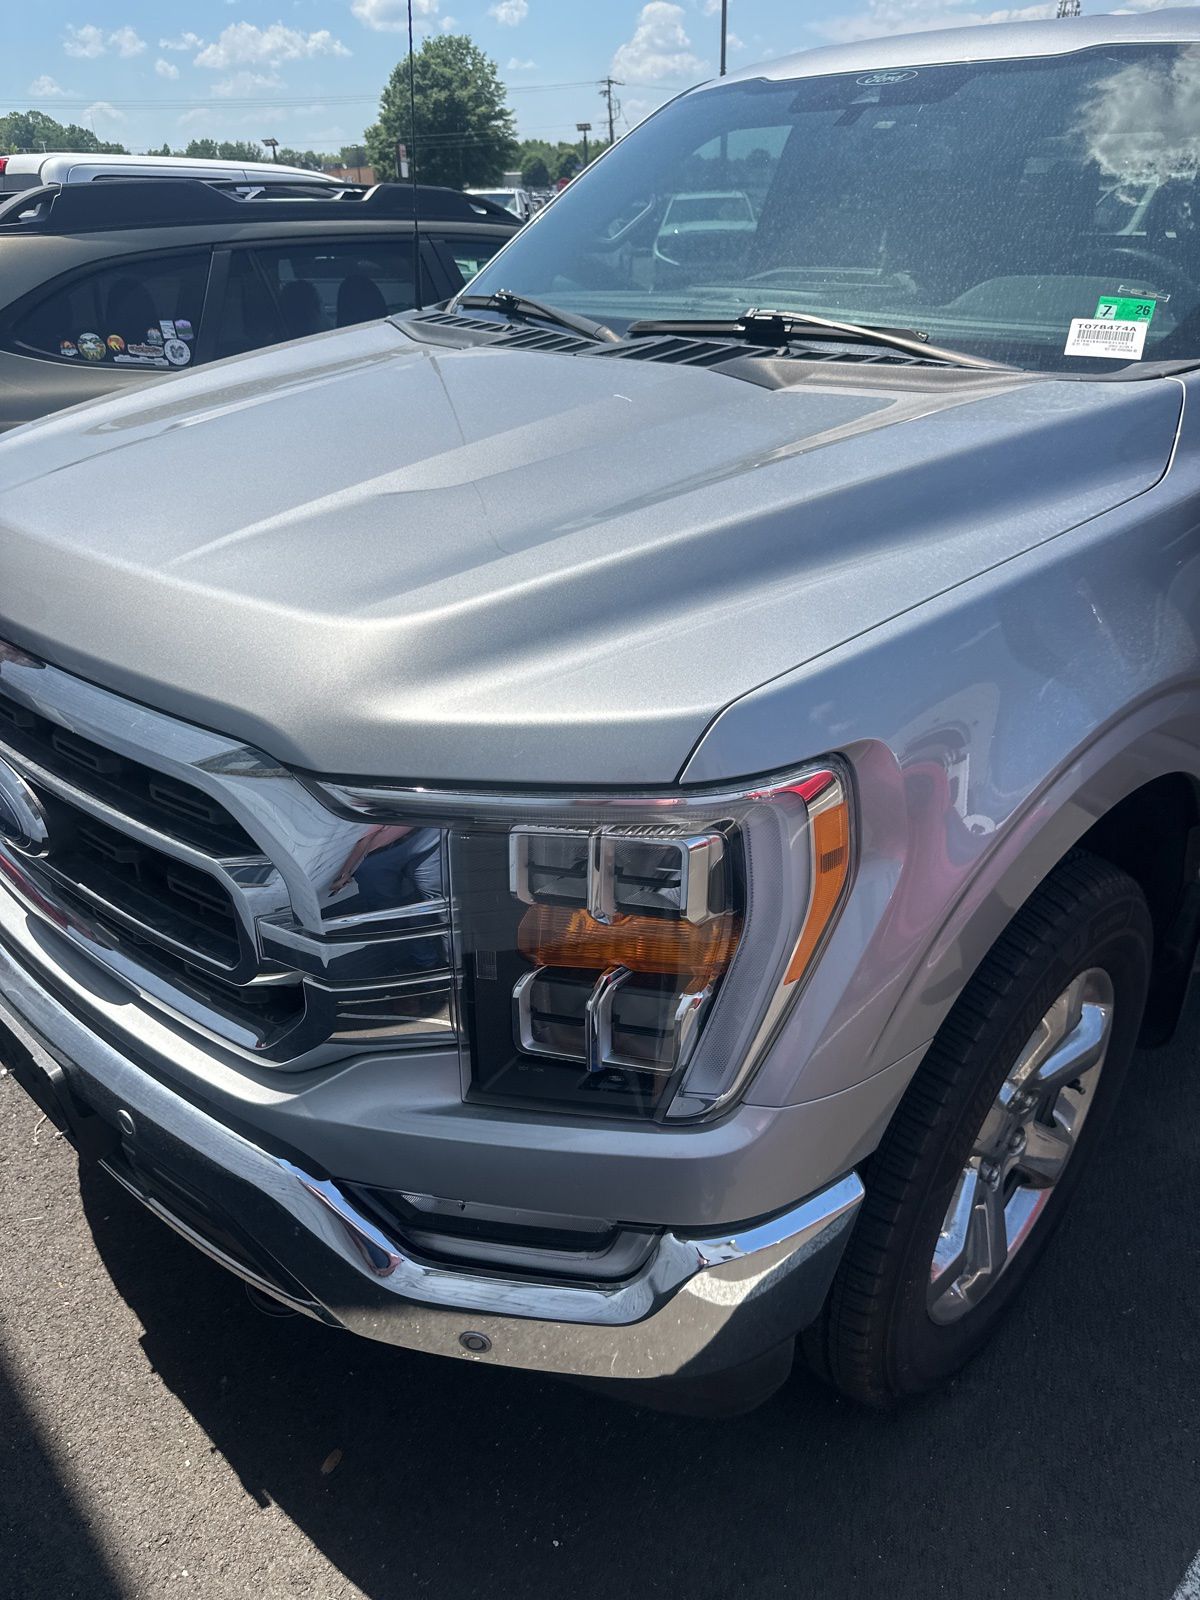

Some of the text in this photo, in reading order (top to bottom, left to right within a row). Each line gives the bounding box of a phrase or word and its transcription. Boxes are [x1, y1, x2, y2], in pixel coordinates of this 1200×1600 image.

[863, 71, 910, 84] Ford
[1102, 304, 1151, 317] 7 26
